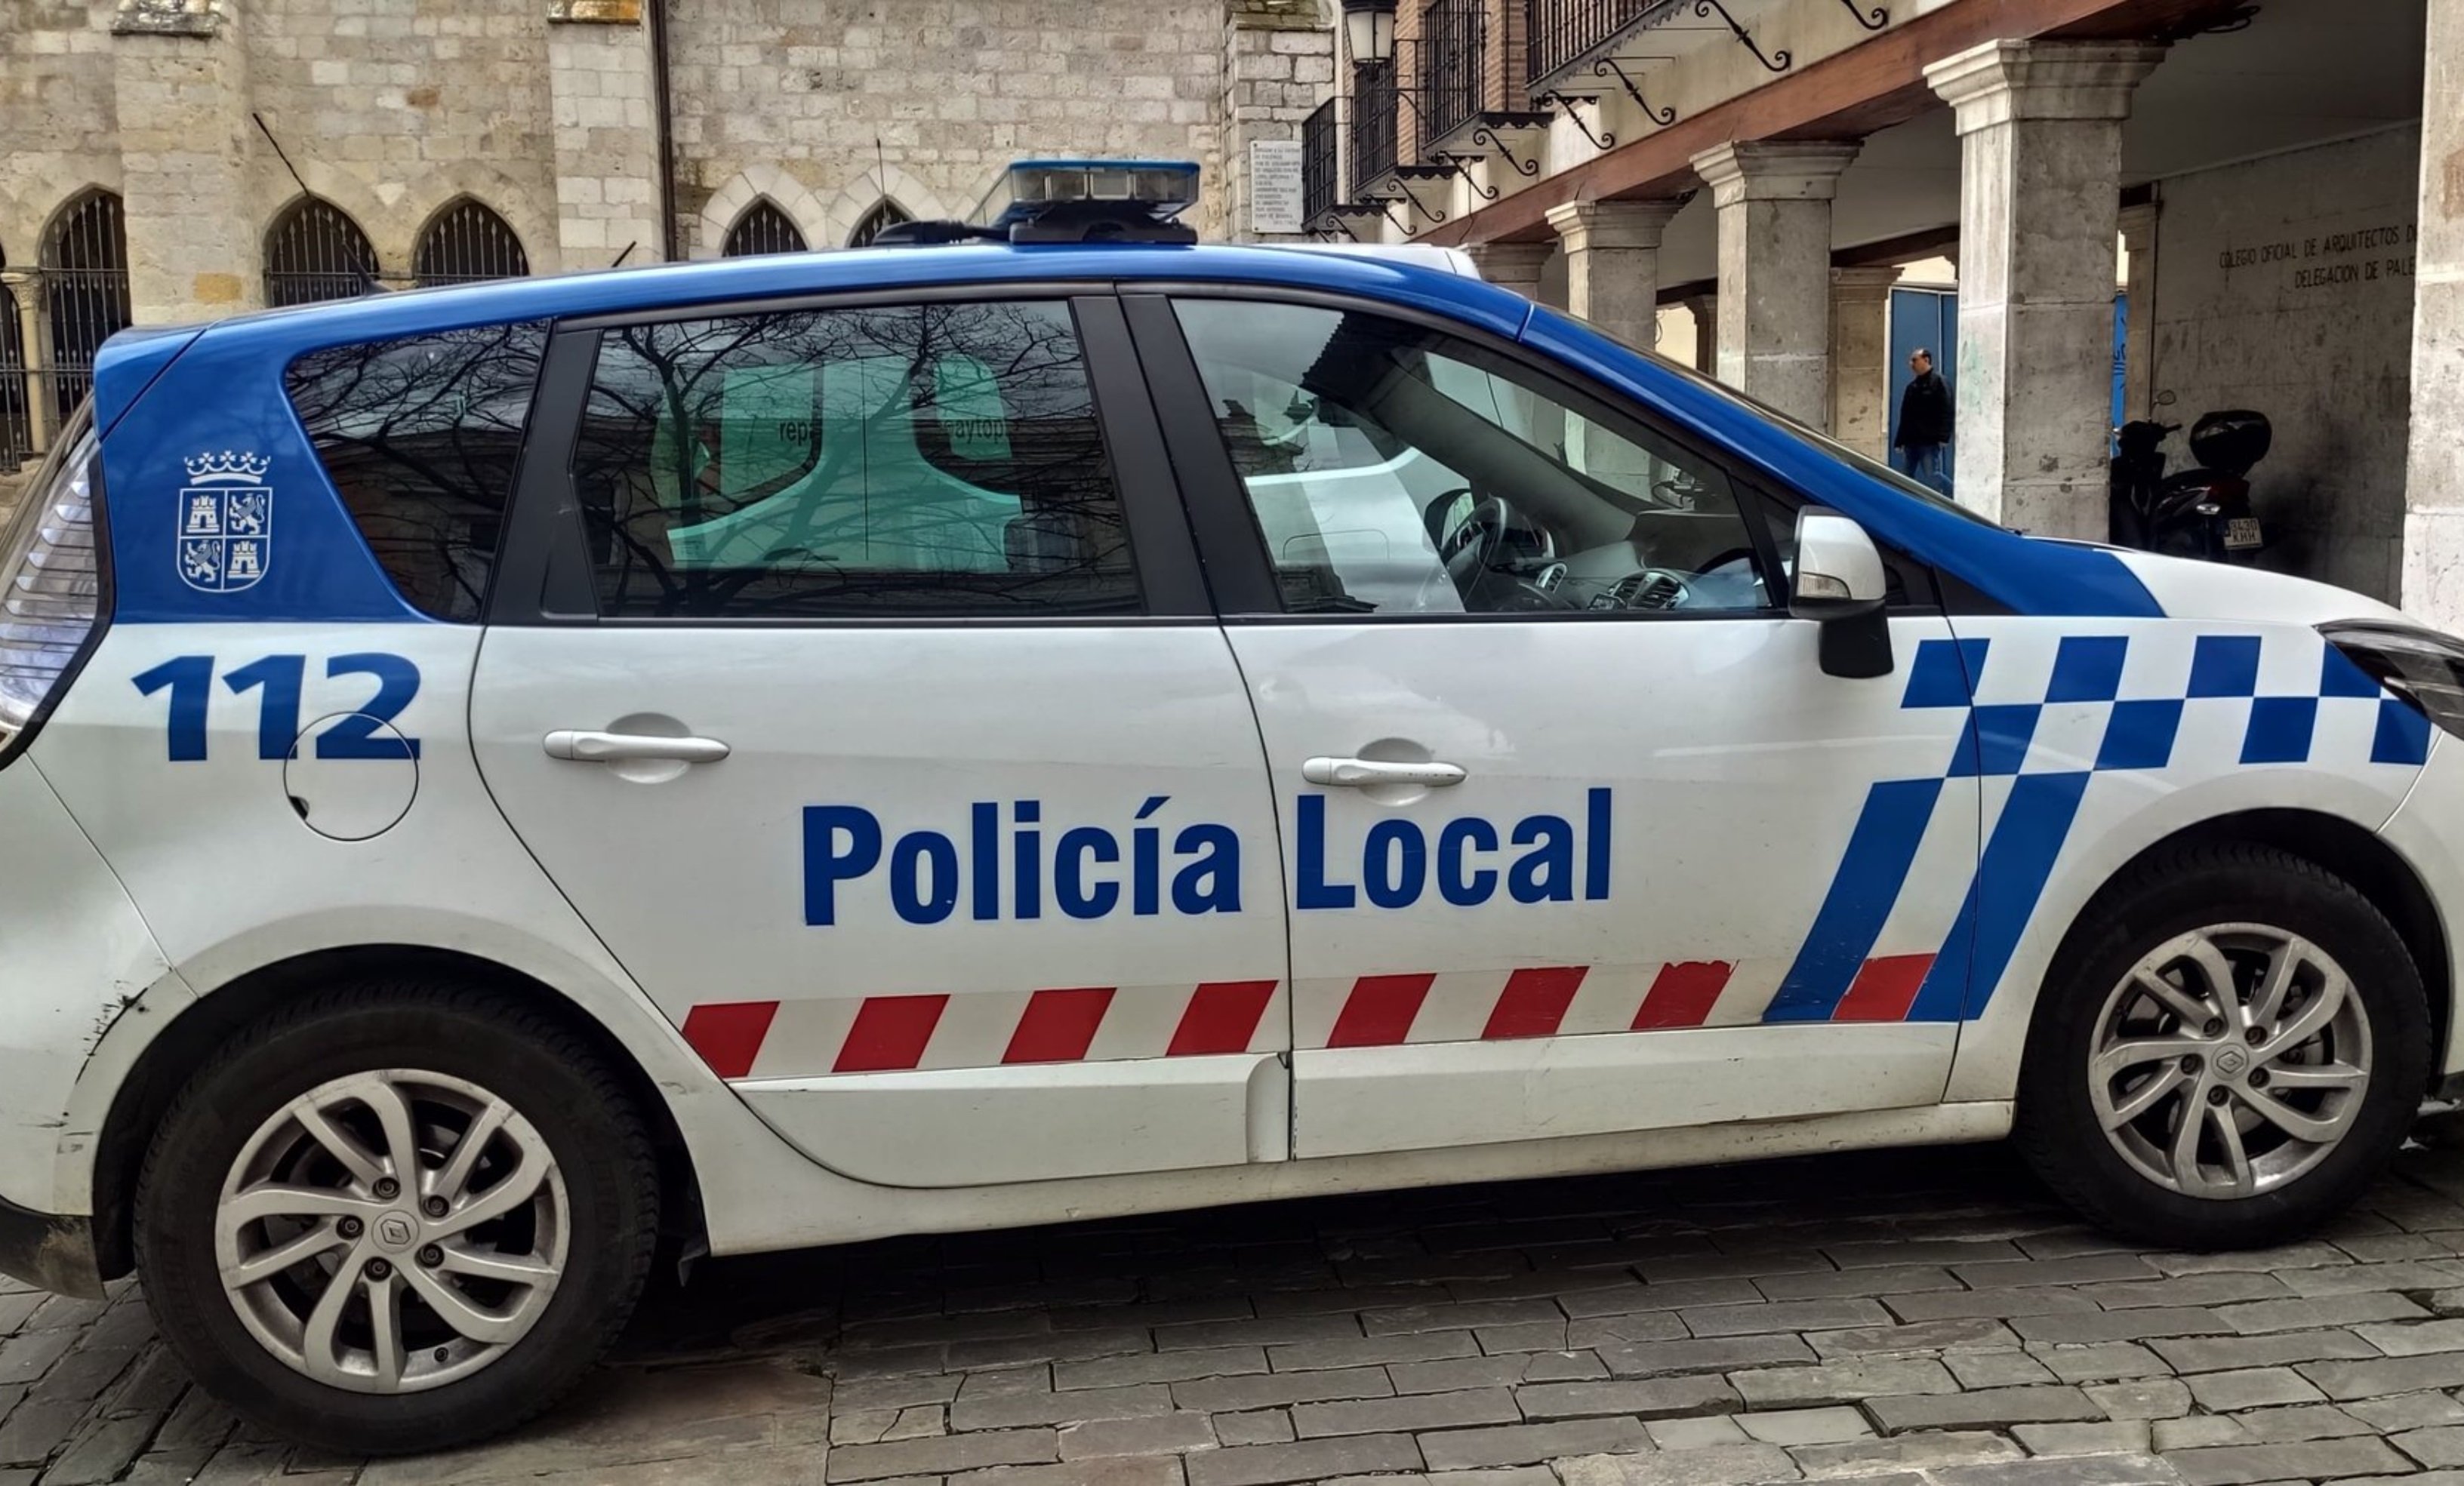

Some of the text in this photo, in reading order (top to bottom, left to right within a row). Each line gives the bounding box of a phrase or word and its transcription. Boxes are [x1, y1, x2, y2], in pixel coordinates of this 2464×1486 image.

[2219, 248, 2256, 269] COLEGIO
[2261, 243, 2297, 263] OFICIAL
[2305, 238, 2318, 257] DE
[2324, 226, 2399, 254] ARQUITECTOS
[2295, 265, 2359, 288] DELEGACION
[2365, 261, 2379, 281] DE
[131, 652, 420, 761] 112
[802, 787, 1612, 926] Policía Local
